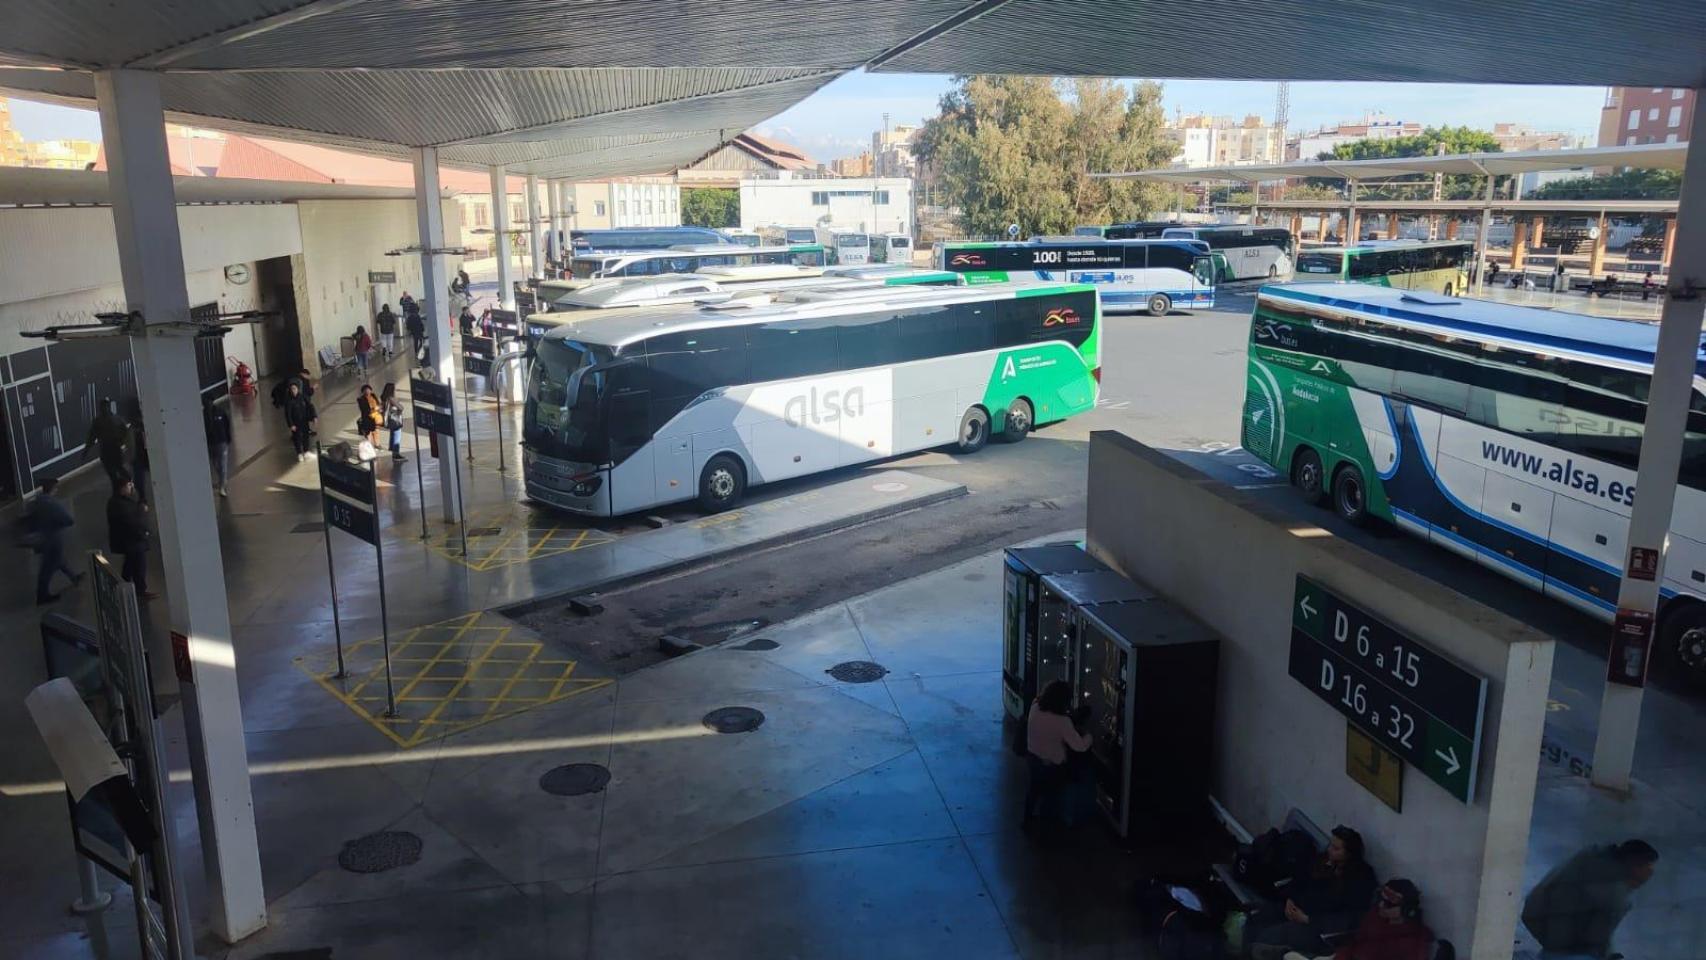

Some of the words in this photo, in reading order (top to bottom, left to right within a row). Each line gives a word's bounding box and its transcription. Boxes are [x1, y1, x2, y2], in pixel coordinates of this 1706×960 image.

[784, 386, 864, 428] alsa
[1482, 440, 1635, 507] www.alsa.es
[1334, 609, 1349, 642] D
[1357, 625, 1370, 656] 6
[1376, 653, 1384, 668] a
[1391, 646, 1420, 687] 15
[1321, 659, 1335, 691] D
[1341, 675, 1367, 715] 16
[1371, 711, 1379, 726] a
[1387, 704, 1415, 749] 32
